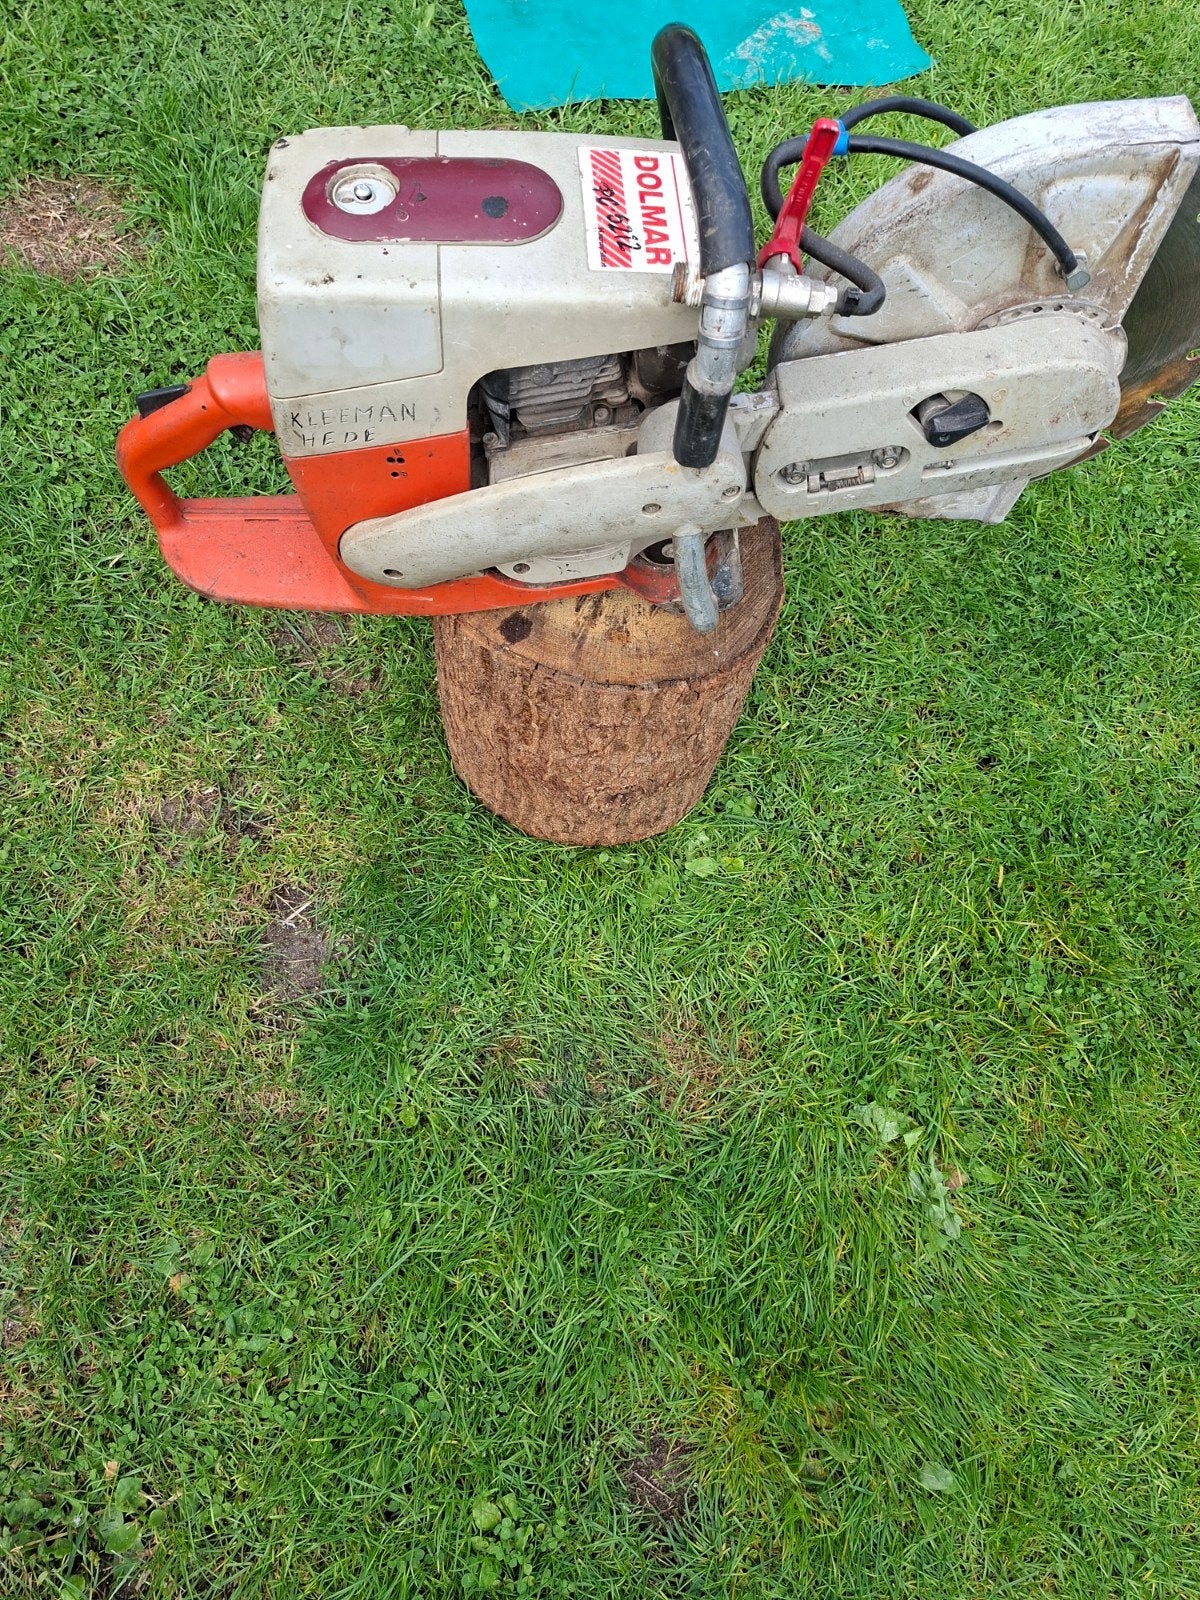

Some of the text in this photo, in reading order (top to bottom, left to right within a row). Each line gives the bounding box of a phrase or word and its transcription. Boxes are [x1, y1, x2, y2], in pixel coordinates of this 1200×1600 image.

[633, 155, 672, 266] DOLMAR
[290, 402, 416, 429] KLEEMAN
[300, 426, 377, 447] HEDE
